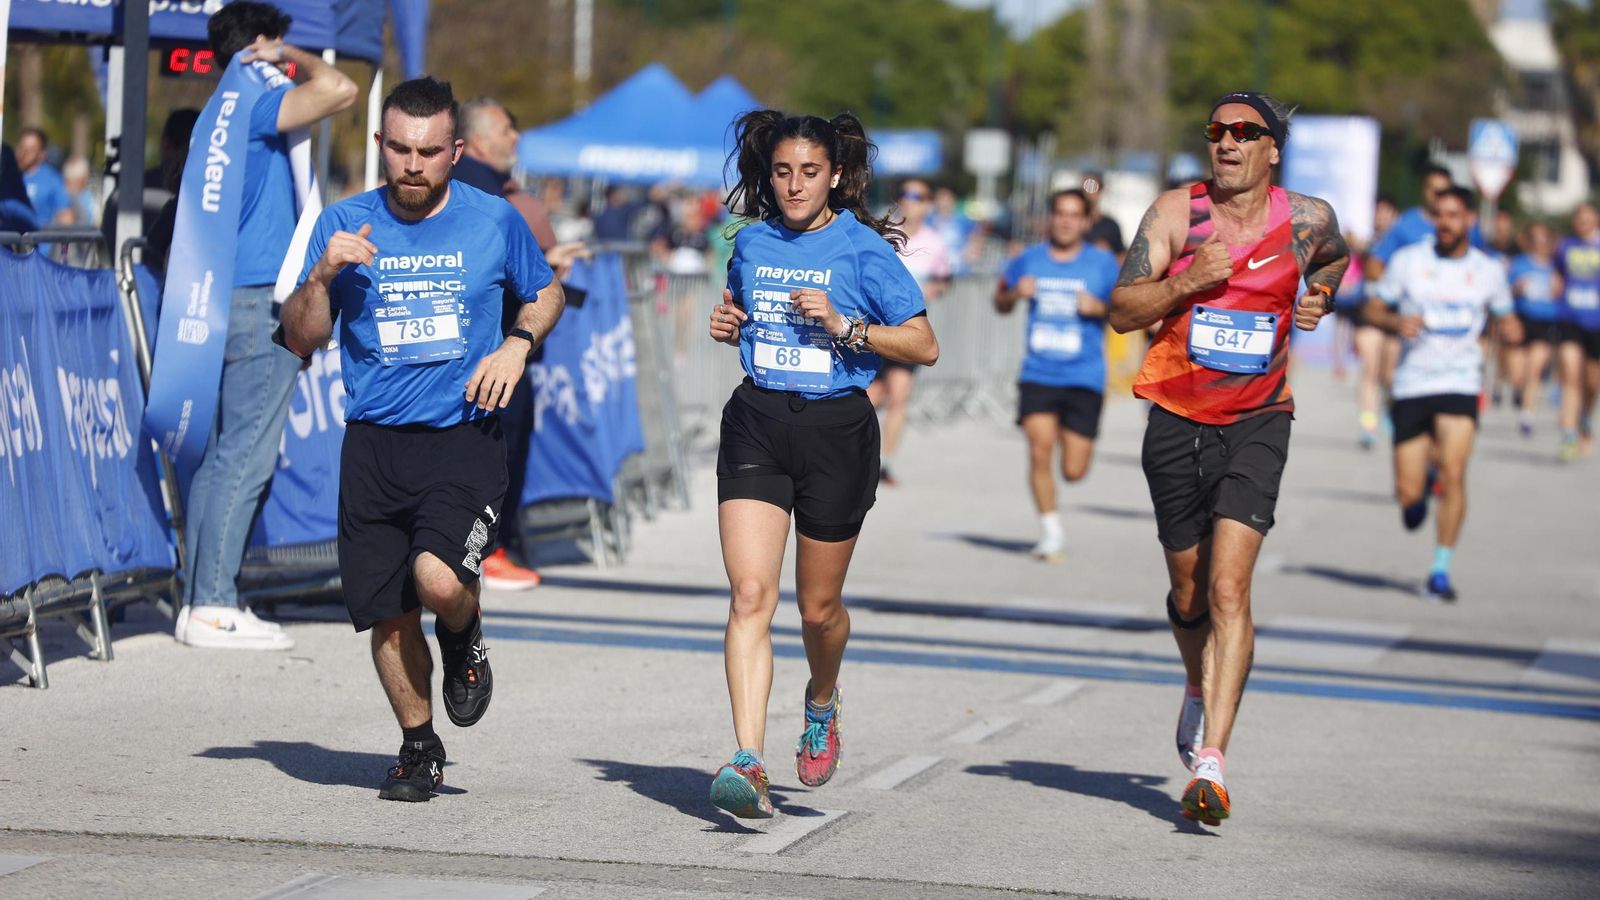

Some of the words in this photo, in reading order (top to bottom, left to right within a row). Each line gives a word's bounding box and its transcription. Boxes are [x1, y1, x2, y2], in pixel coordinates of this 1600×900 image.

[202, 91, 240, 213] mayoral
[379, 251, 463, 272] mayoral
[755, 266, 832, 286] mayoral
[379, 280, 462, 293] RUNNING
[396, 318, 436, 340] 736
[1214, 329, 1253, 349] 647
[382, 346, 399, 354] 10KM
[776, 347, 801, 367] 68
